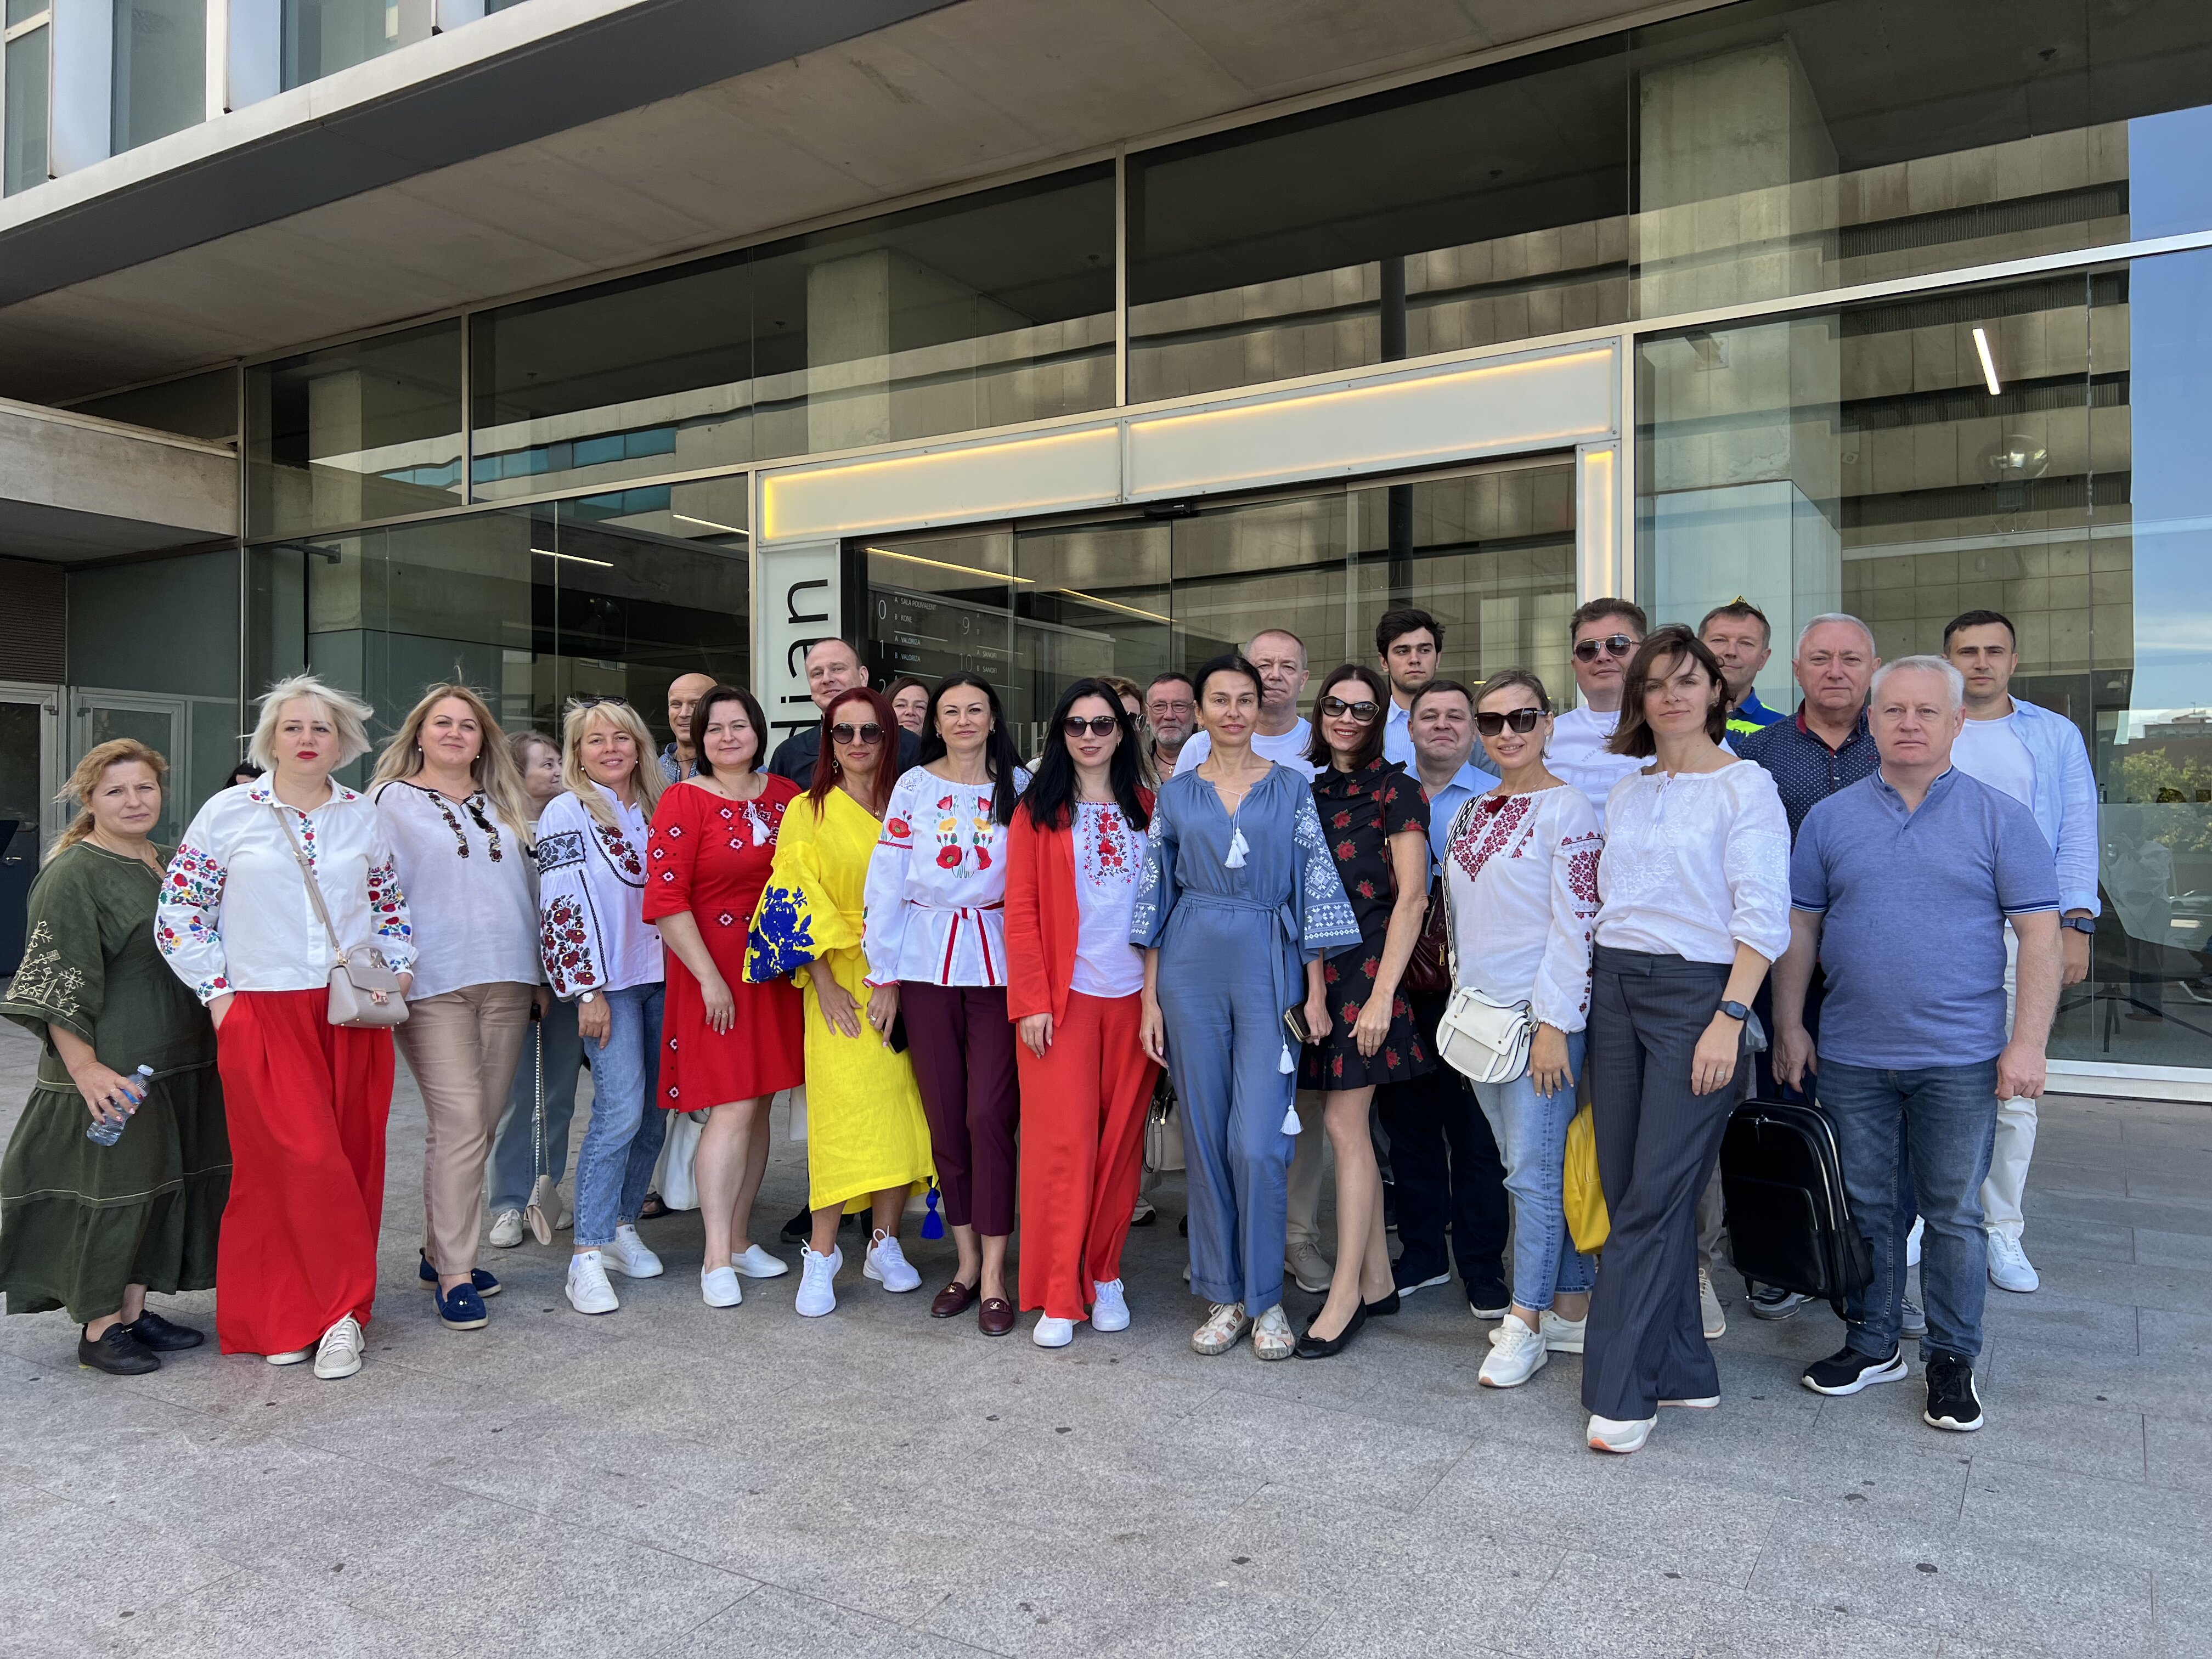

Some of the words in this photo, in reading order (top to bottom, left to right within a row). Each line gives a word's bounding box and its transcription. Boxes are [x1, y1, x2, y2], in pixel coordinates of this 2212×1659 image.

[900, 597, 912, 606] SALA
[878, 600, 887, 619] 0
[900, 614, 913, 623] KONE
[962, 617, 970, 635] 9
[901, 636, 921, 646] VALORIZA
[879, 640, 884, 659] 1
[901, 653, 921, 662] VALORIZA
[982, 651, 997, 659] SANOFI
[959, 653, 973, 673] 10
[983, 666, 997, 674] SANOFI
